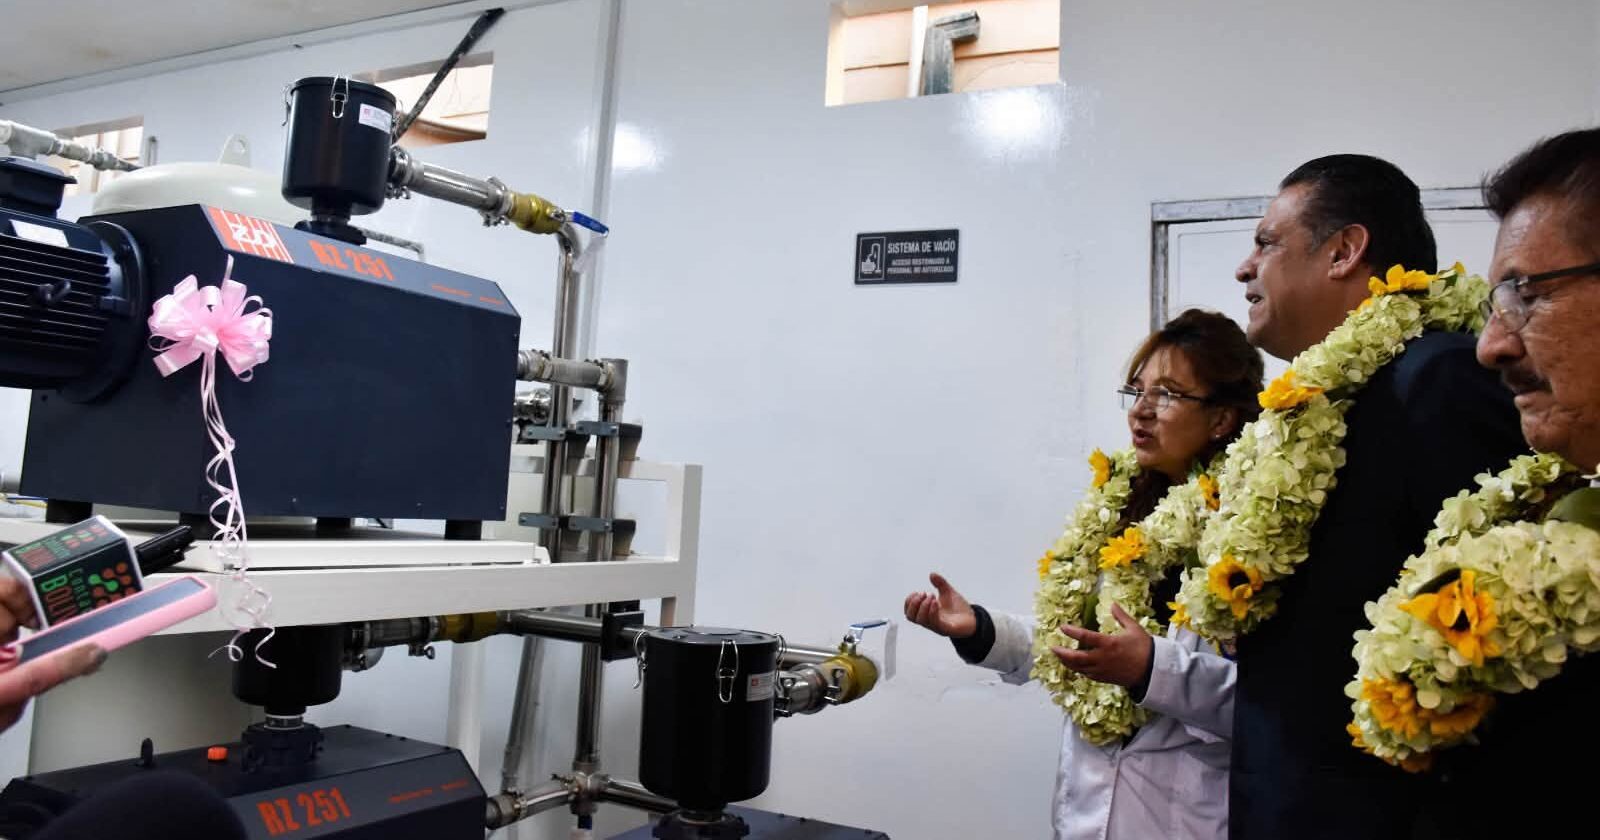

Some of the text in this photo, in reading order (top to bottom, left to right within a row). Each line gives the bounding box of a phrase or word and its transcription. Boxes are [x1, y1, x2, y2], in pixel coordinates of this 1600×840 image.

[309, 240, 396, 281] RZ 251
[887, 238, 956, 254] SISTEMA DE VACÍO
[257, 798, 300, 836] RZ
[296, 787, 351, 827] 251
